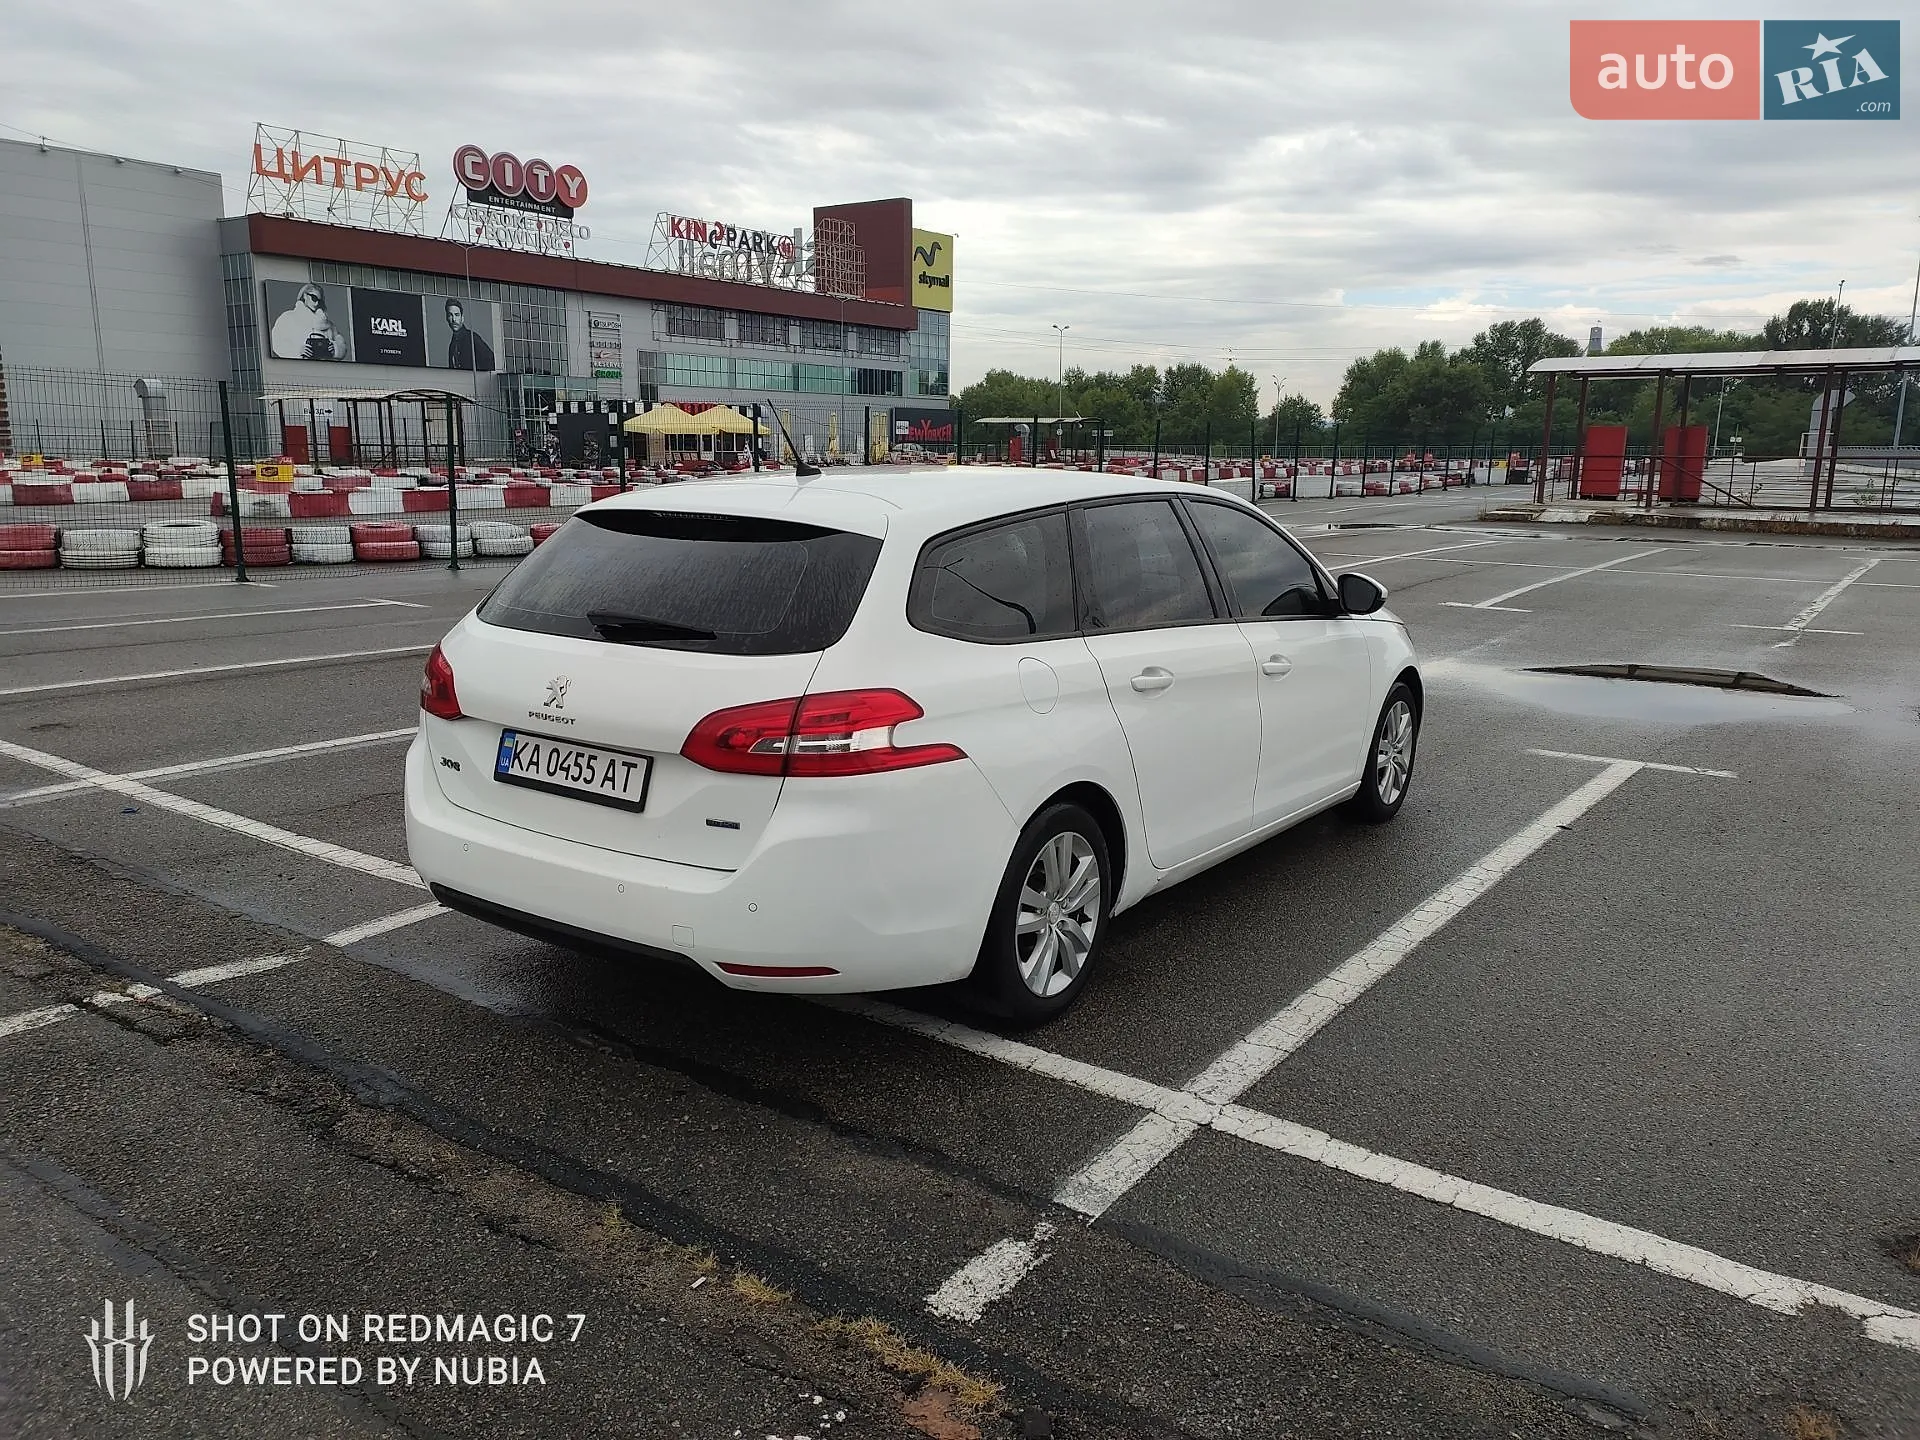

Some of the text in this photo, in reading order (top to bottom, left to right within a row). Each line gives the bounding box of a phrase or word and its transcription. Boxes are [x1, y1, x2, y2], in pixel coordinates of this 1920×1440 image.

[253, 143, 429, 202] ЦИТРУС
[462, 153, 583, 199] CITY
[488, 196, 556, 213] ENTERTAINMENT
[452, 205, 590, 240] KARAOKE DISCO
[485, 224, 561, 250] BOWLING
[918, 271, 949, 288] skymall
[371, 317, 407, 333] KARL
[528, 711, 576, 725] PEUGEOT
[440, 757, 461, 771] 308
[501, 757, 510, 767] UA
[510, 740, 638, 793] KA 0455 AT
